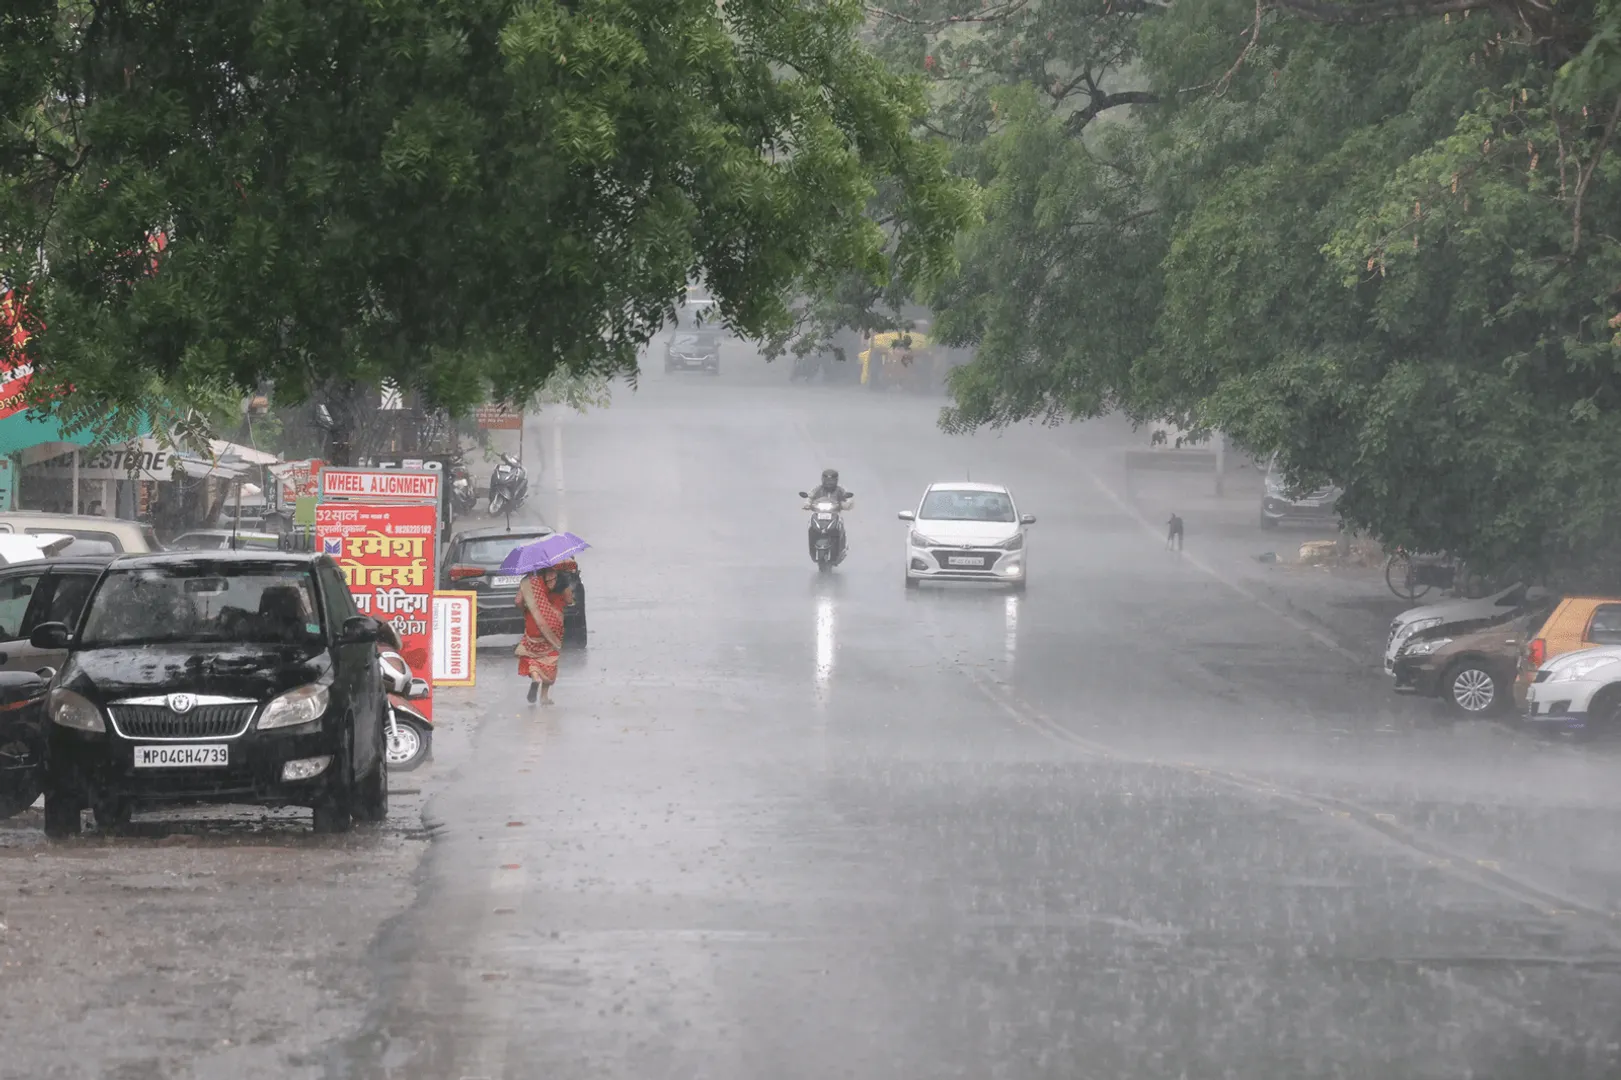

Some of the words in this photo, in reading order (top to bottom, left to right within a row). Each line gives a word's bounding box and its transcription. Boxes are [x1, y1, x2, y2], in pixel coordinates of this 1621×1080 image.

[327, 475, 364, 491] WHEEL
[370, 477, 434, 493] ALIGNMENT
[346, 530, 427, 558] रमेश
[450, 602, 462, 623] CAR
[450, 627, 461, 675] WASHING
[143, 749, 227, 763] MP04CH4739
